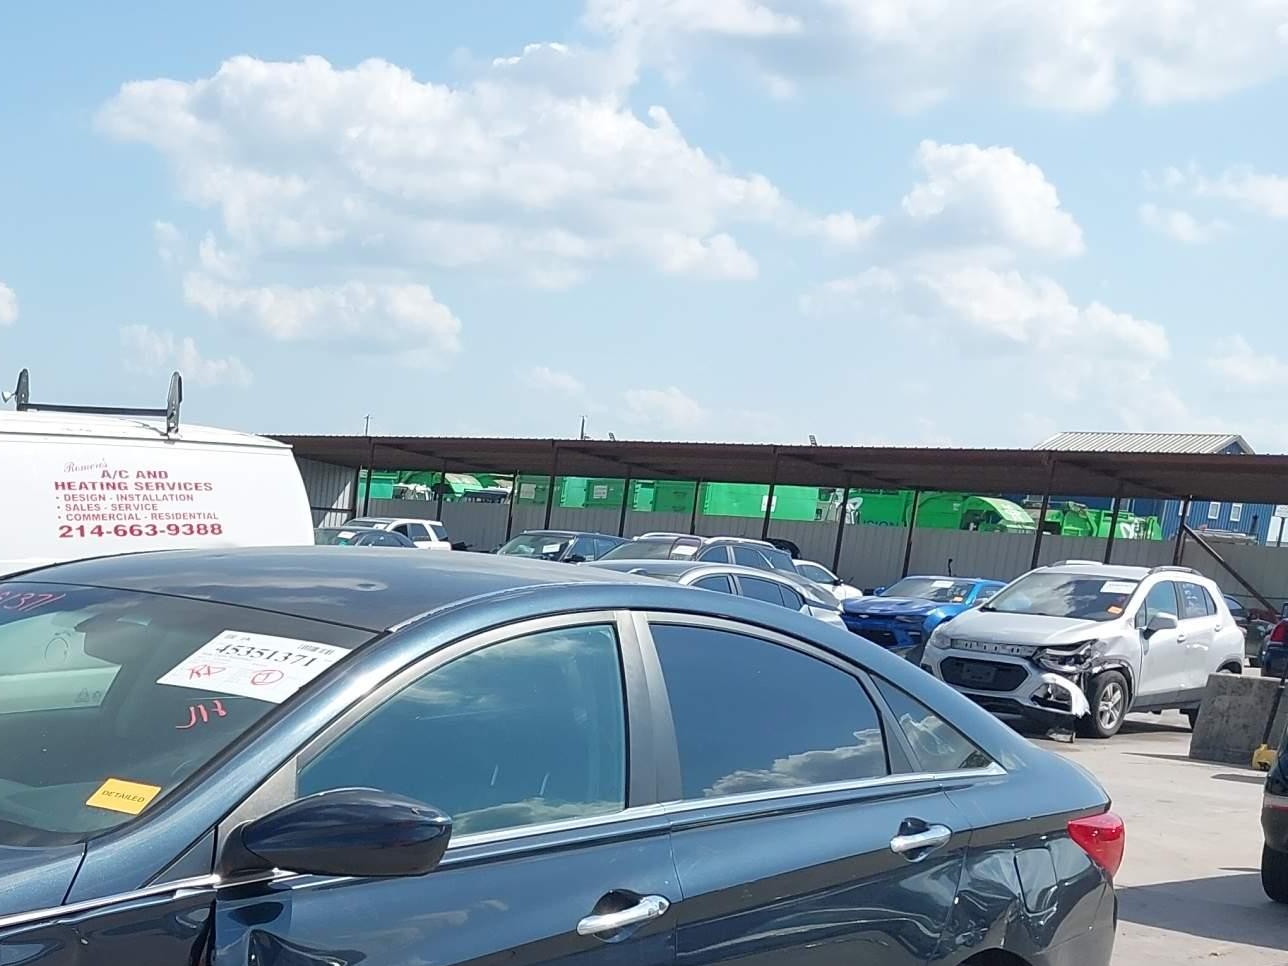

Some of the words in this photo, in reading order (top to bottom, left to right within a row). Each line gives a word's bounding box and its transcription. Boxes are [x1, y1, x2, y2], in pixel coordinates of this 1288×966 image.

[101, 469, 129, 480] A/C
[136, 470, 169, 480] AND
[54, 481, 129, 491] HEATING
[134, 481, 213, 492] SERVICES
[63, 493, 107, 502] DESIGN
[116, 493, 195, 502] INSTALLATION
[65, 503, 102, 512] SALES
[111, 503, 159, 512] SERVICE
[66, 513, 142, 521] COMMERCIAL
[150, 512, 219, 521] RESIDENTIAL
[58, 523, 224, 538] 214-663-9388
[216, 643, 318, 668] 45351371
[102, 790, 146, 803] DETAILED
